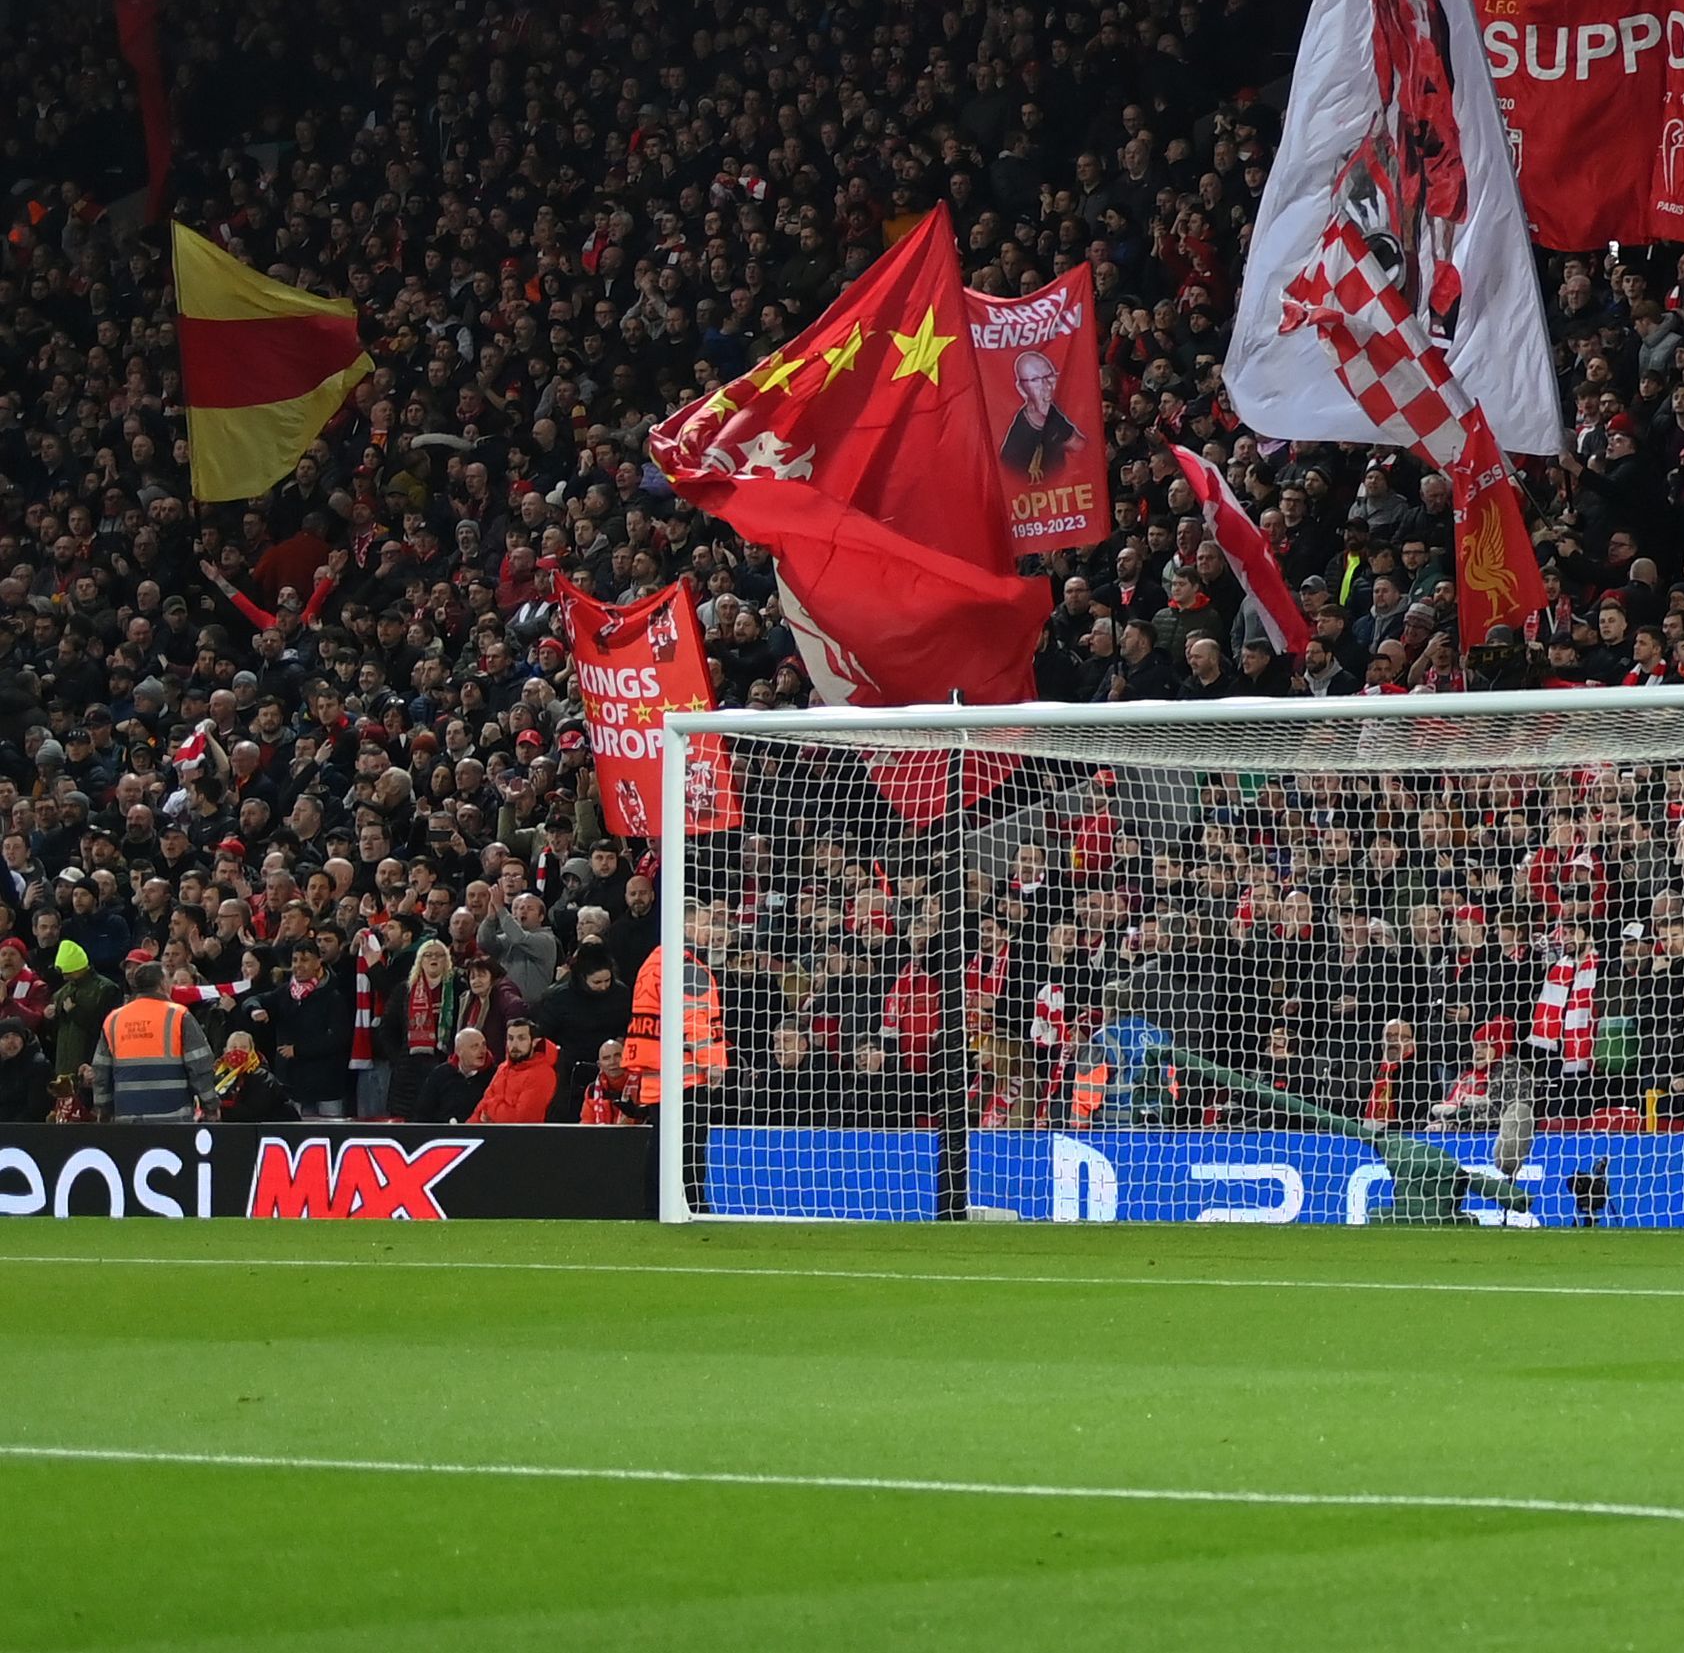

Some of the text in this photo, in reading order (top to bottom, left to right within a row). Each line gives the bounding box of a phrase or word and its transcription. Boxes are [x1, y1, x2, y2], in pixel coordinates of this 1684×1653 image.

[1656, 200, 1684, 216] PARIS
[985, 287, 1067, 324] GARRY
[1011, 514, 1087, 539] 1959-2023
[577, 659, 661, 698] KINGS
[601, 700, 628, 725] OF
[589, 722, 666, 760] UROP
[246, 1137, 485, 1220] MAX
